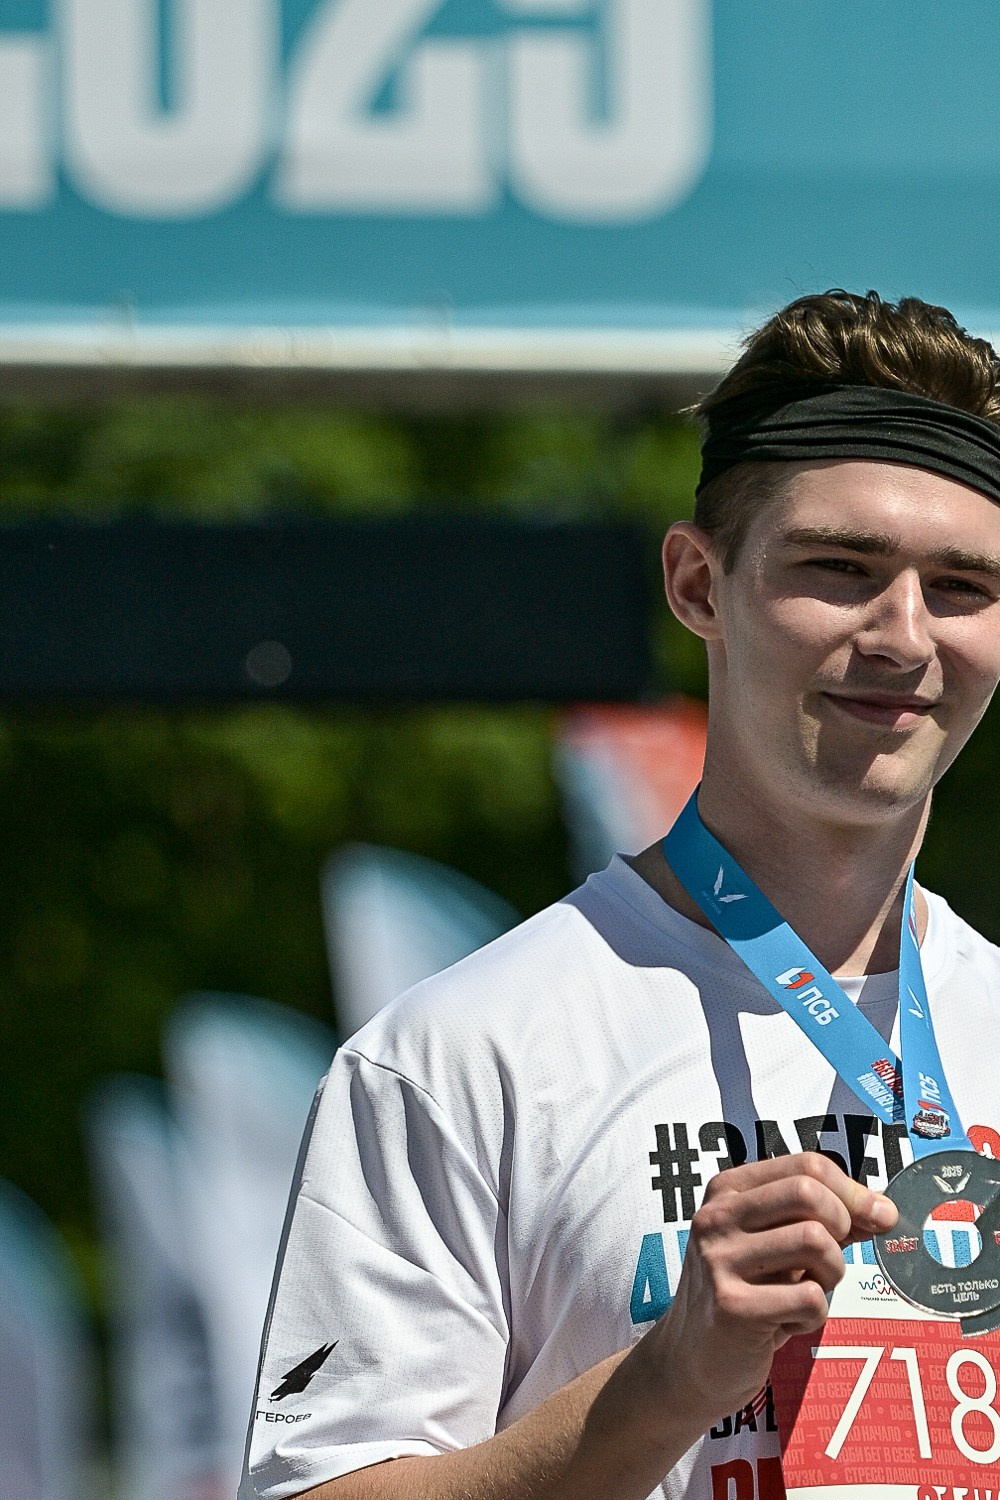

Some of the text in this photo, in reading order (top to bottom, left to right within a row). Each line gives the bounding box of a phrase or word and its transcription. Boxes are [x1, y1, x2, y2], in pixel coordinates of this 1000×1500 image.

[798, 986, 839, 1027] ПСБ
[918, 1071, 943, 1106] ПСБ
[931, 1279, 999, 1296] ЕСТЬ ТОЛЬКО
[952, 1291, 980, 1304] ЦЕЛЬ
[861, 1425, 902, 1442] НАЧАЛО
[863, 1446, 881, 1462] БЕГ
[891, 1446, 918, 1464] СЕБЕ
